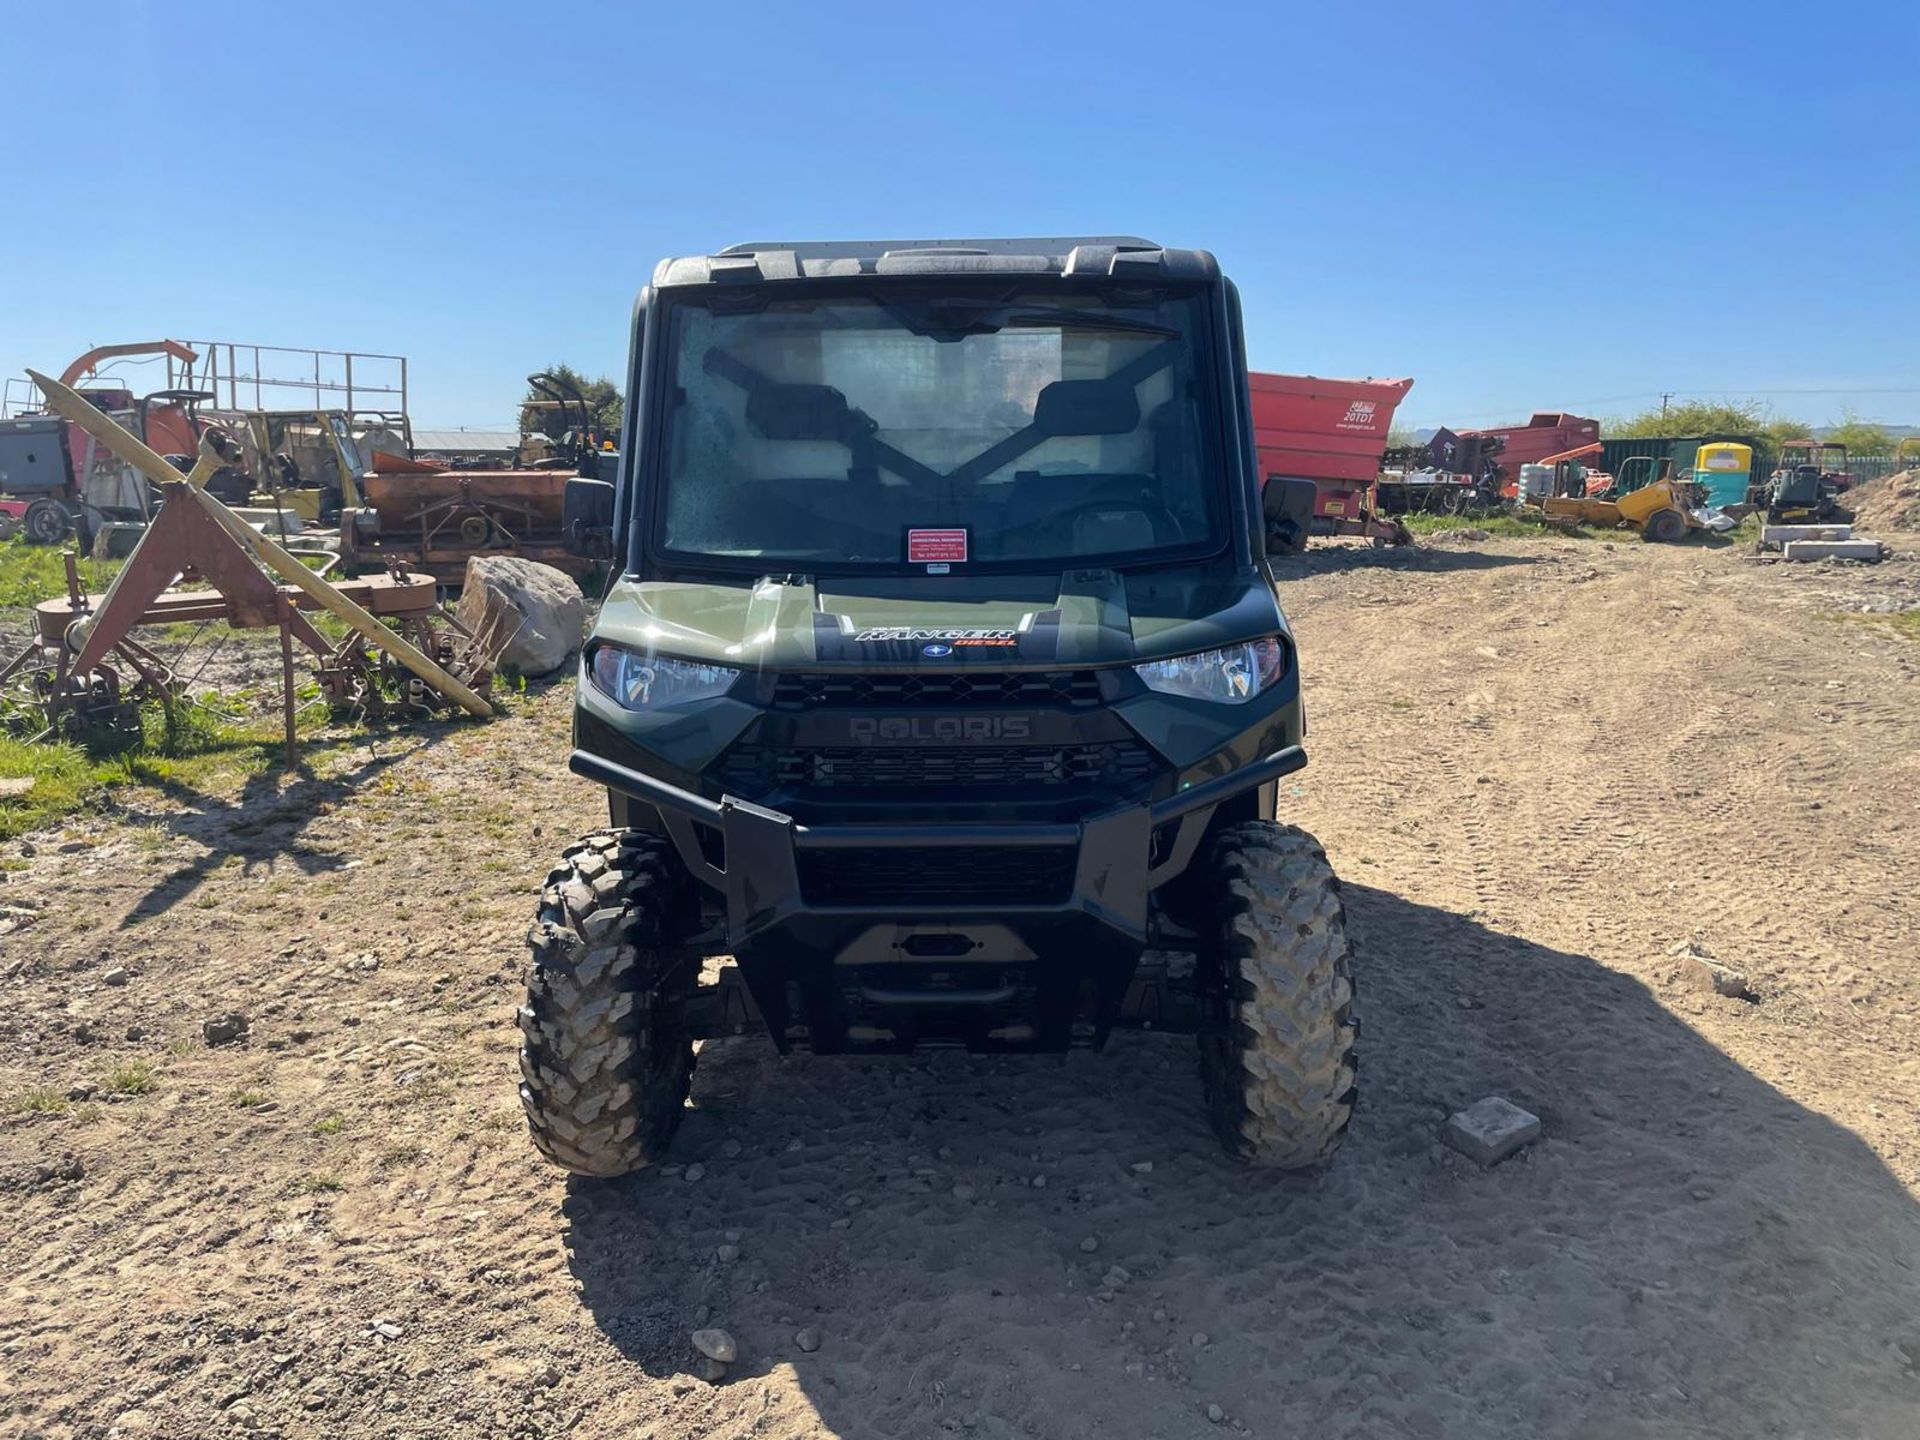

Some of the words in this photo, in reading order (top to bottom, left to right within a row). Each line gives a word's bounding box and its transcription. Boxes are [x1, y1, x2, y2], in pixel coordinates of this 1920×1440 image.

[1344, 412, 1376, 423] 20TDT
[855, 629, 1015, 641] RANGER
[849, 717, 1030, 740] POLARIS
